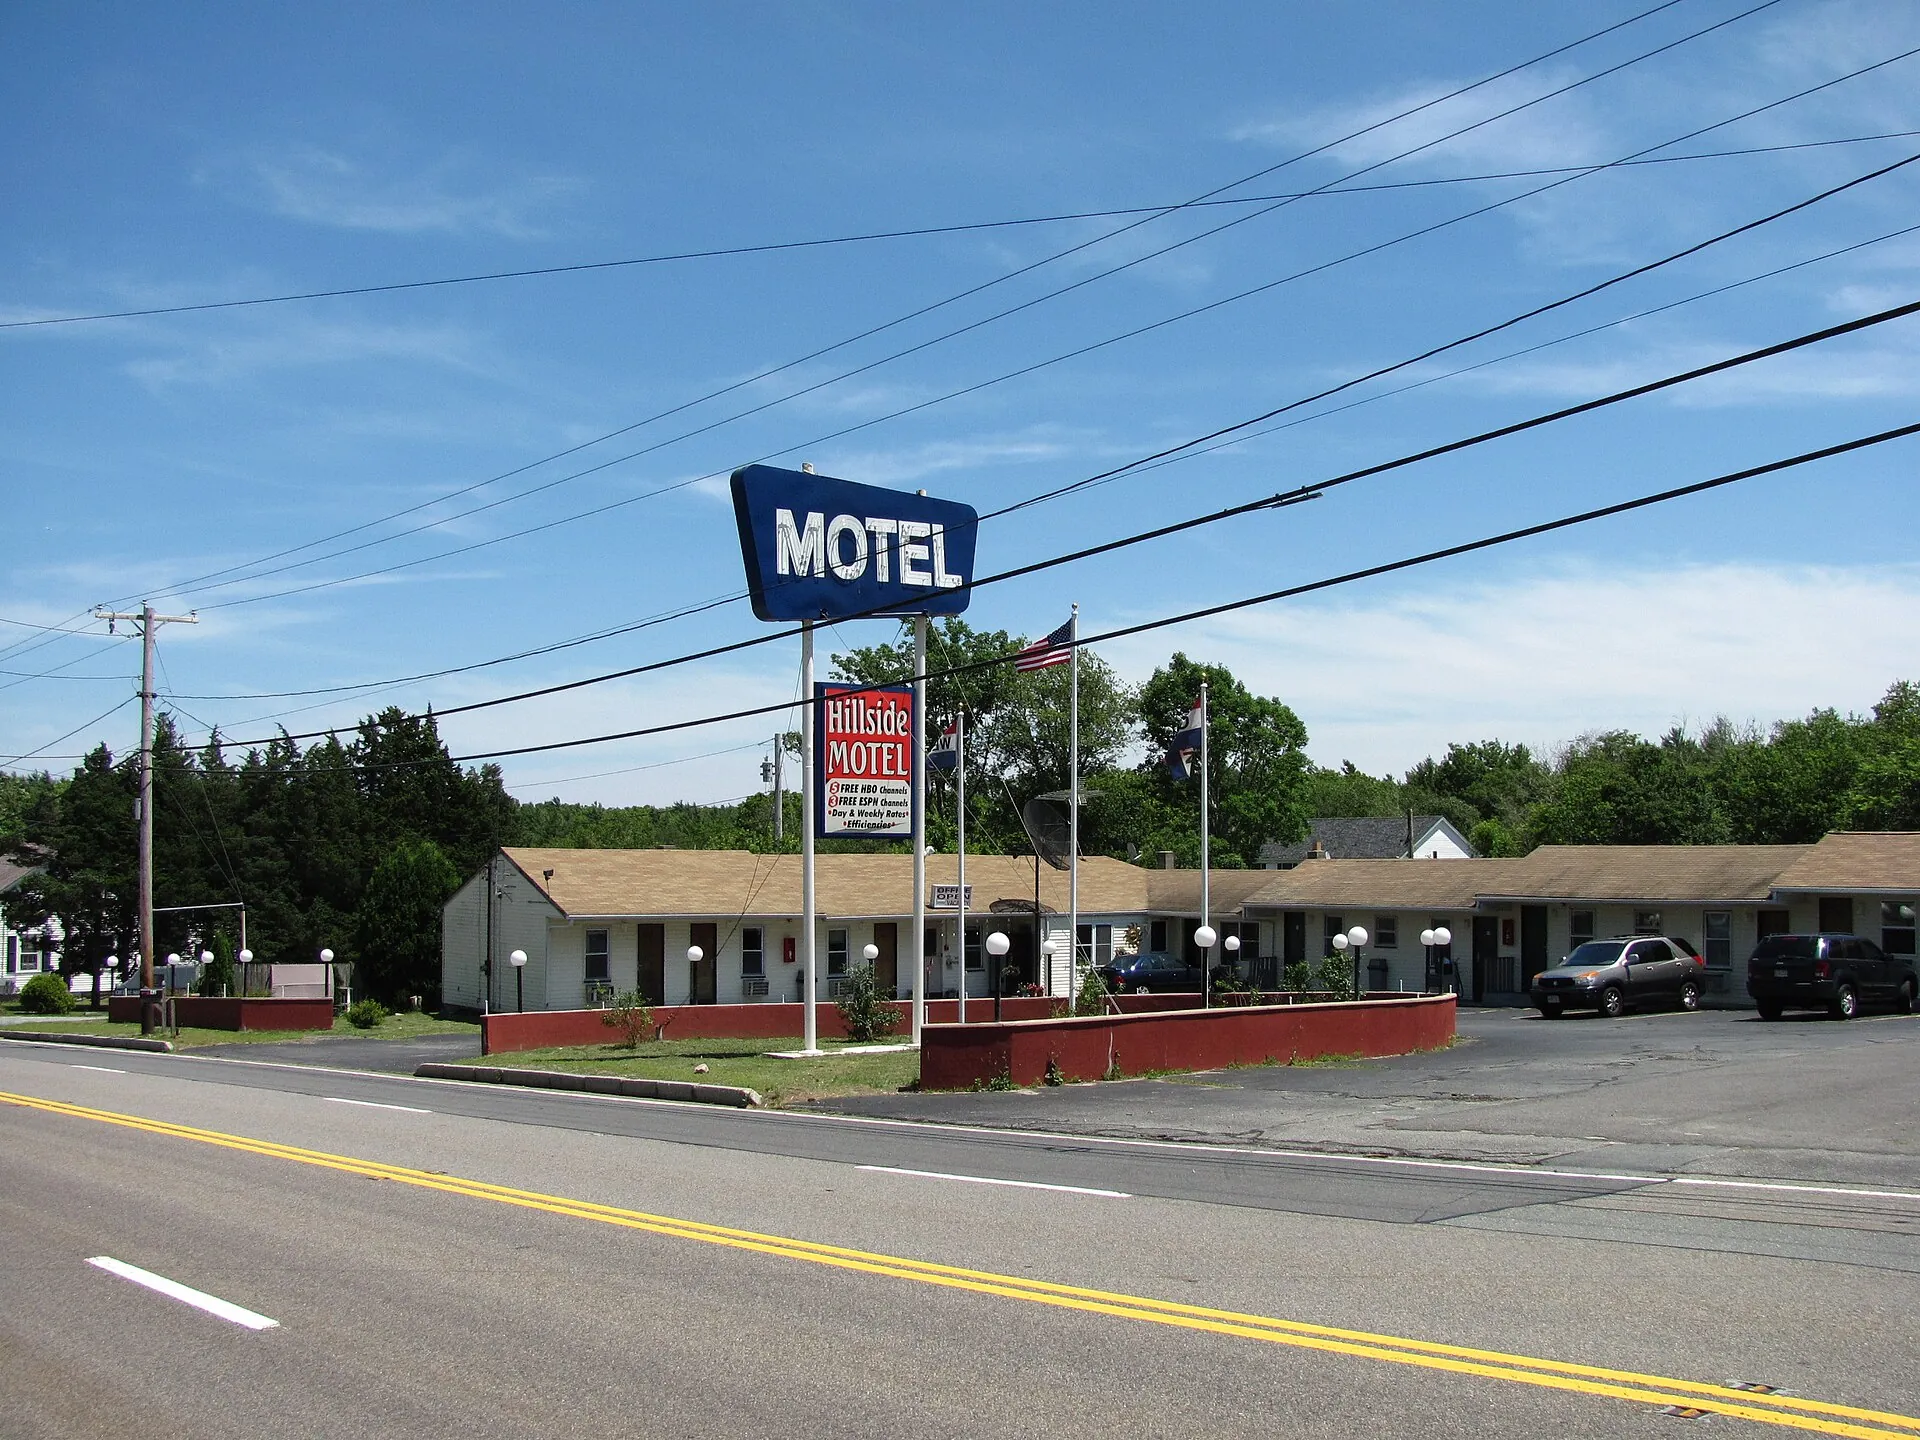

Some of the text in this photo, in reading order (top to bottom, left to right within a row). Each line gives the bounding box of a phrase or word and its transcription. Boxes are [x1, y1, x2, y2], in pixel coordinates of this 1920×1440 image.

[776, 508, 963, 588] MOTEL
[828, 698, 908, 737] Hillside
[828, 740, 909, 776] MOTEL
[840, 784, 859, 794] FREE
[861, 784, 877, 794] HBO
[880, 786, 908, 795] Channels
[839, 796, 857, 806] FREE
[859, 797, 879, 806] ESPN
[880, 798, 909, 807] Channels
[832, 809, 906, 819] Day & Weekly Rates
[847, 819, 892, 829] Efficiencies
